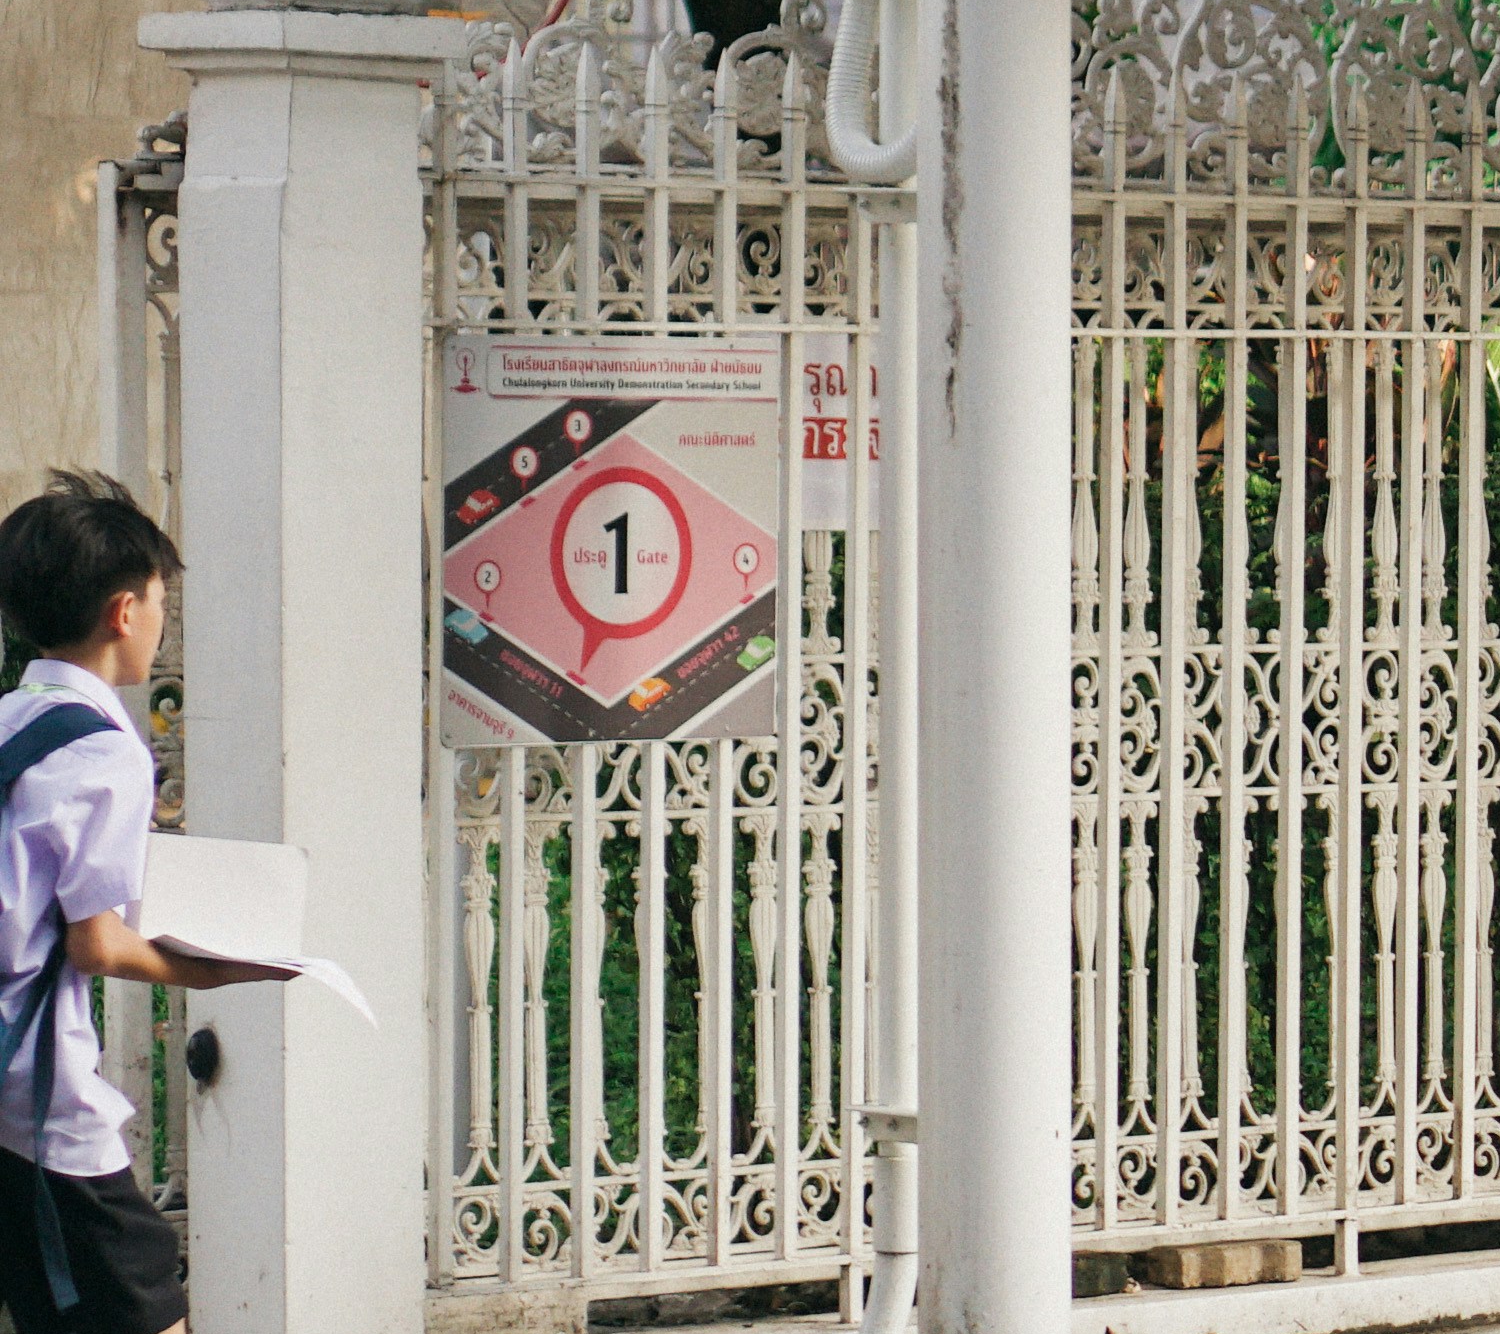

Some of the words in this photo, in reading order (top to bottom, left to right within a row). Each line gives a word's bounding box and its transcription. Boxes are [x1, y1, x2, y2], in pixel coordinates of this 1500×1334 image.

[502, 377, 568, 390] Chulalongkorn
[570, 378, 615, 391] University
[617, 378, 683, 389] Demonstration
[686, 380, 730, 391] Secondary
[733, 381, 761, 390] School
[574, 420, 582, 432] 3
[521, 455, 529, 468] 5
[573, 547, 607, 569] ประตู
[603, 512, 629, 594] 1
[636, 549, 669, 564] Gate
[742, 553, 750, 565] 4
[484, 570, 492, 583] 2
